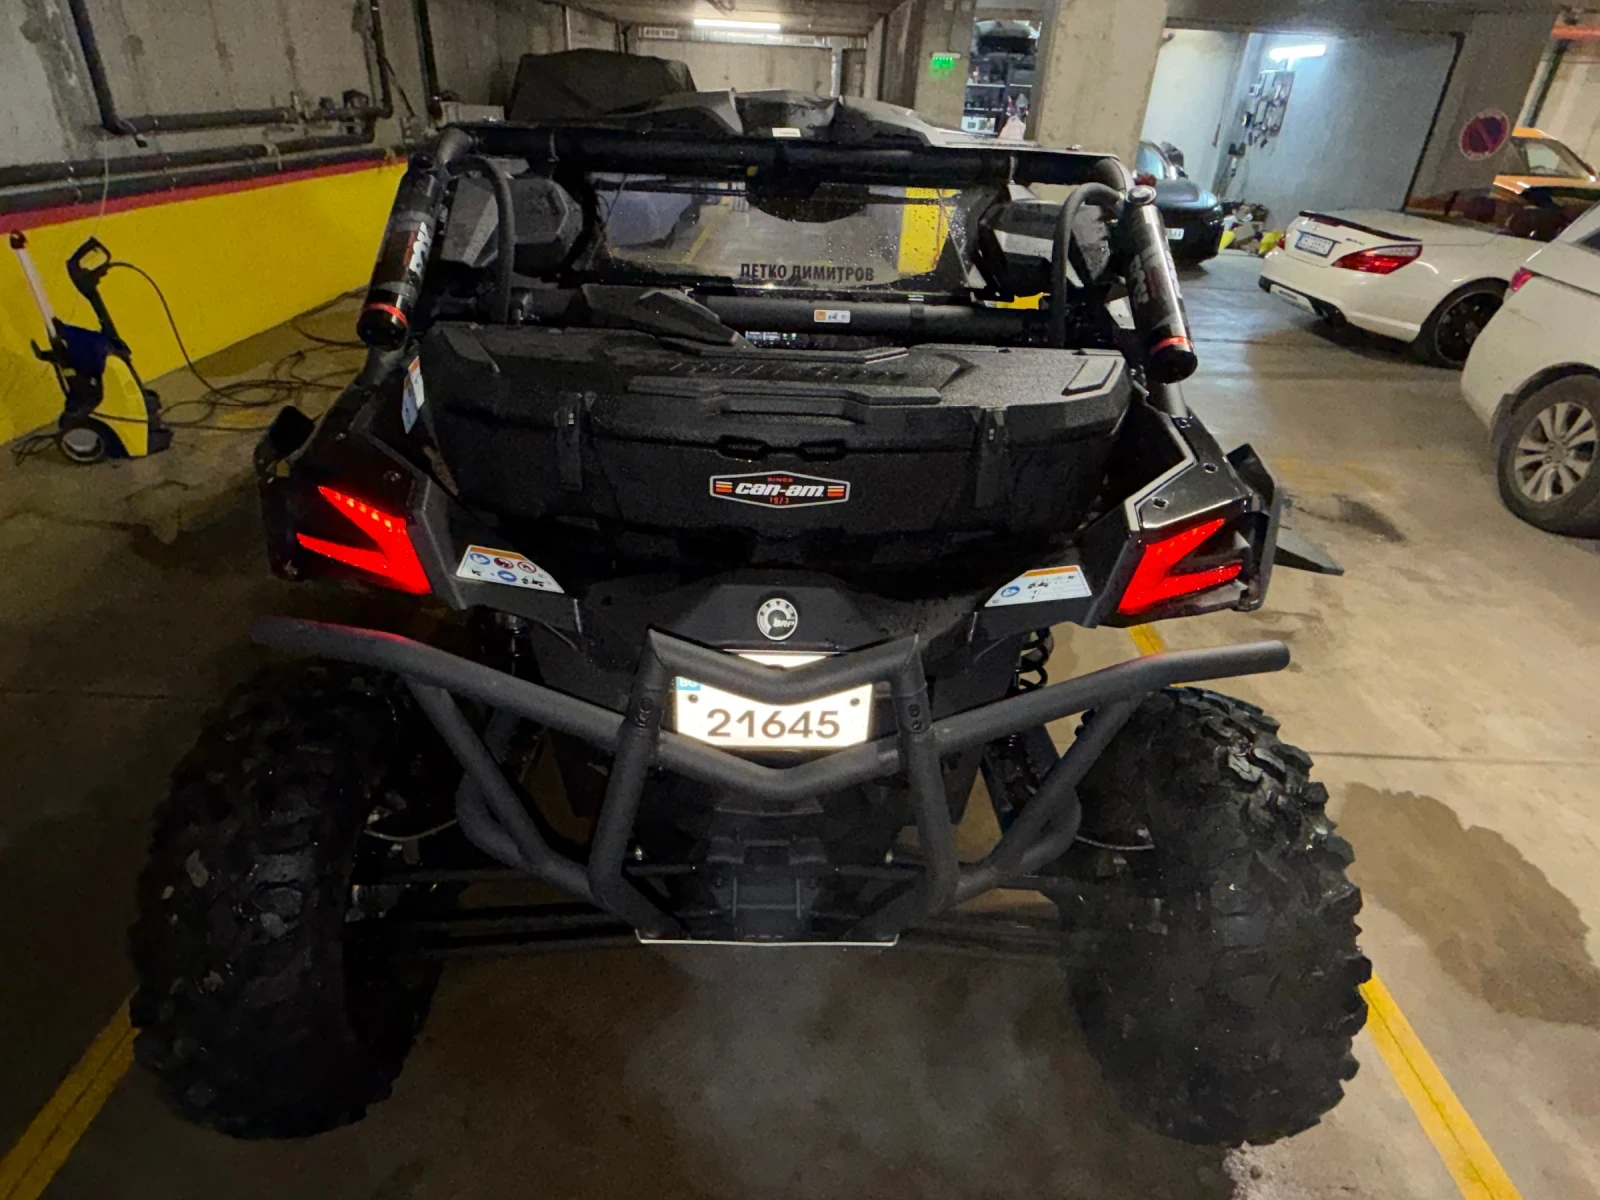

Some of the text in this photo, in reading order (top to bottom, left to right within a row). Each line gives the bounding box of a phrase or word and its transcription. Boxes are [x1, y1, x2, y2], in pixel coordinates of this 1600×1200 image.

[740, 263, 875, 283] ПЕТКО ДИМИТРОВ
[735, 482, 824, 497] can-am
[772, 617, 796, 628] BRP
[707, 708, 841, 739] 21645
